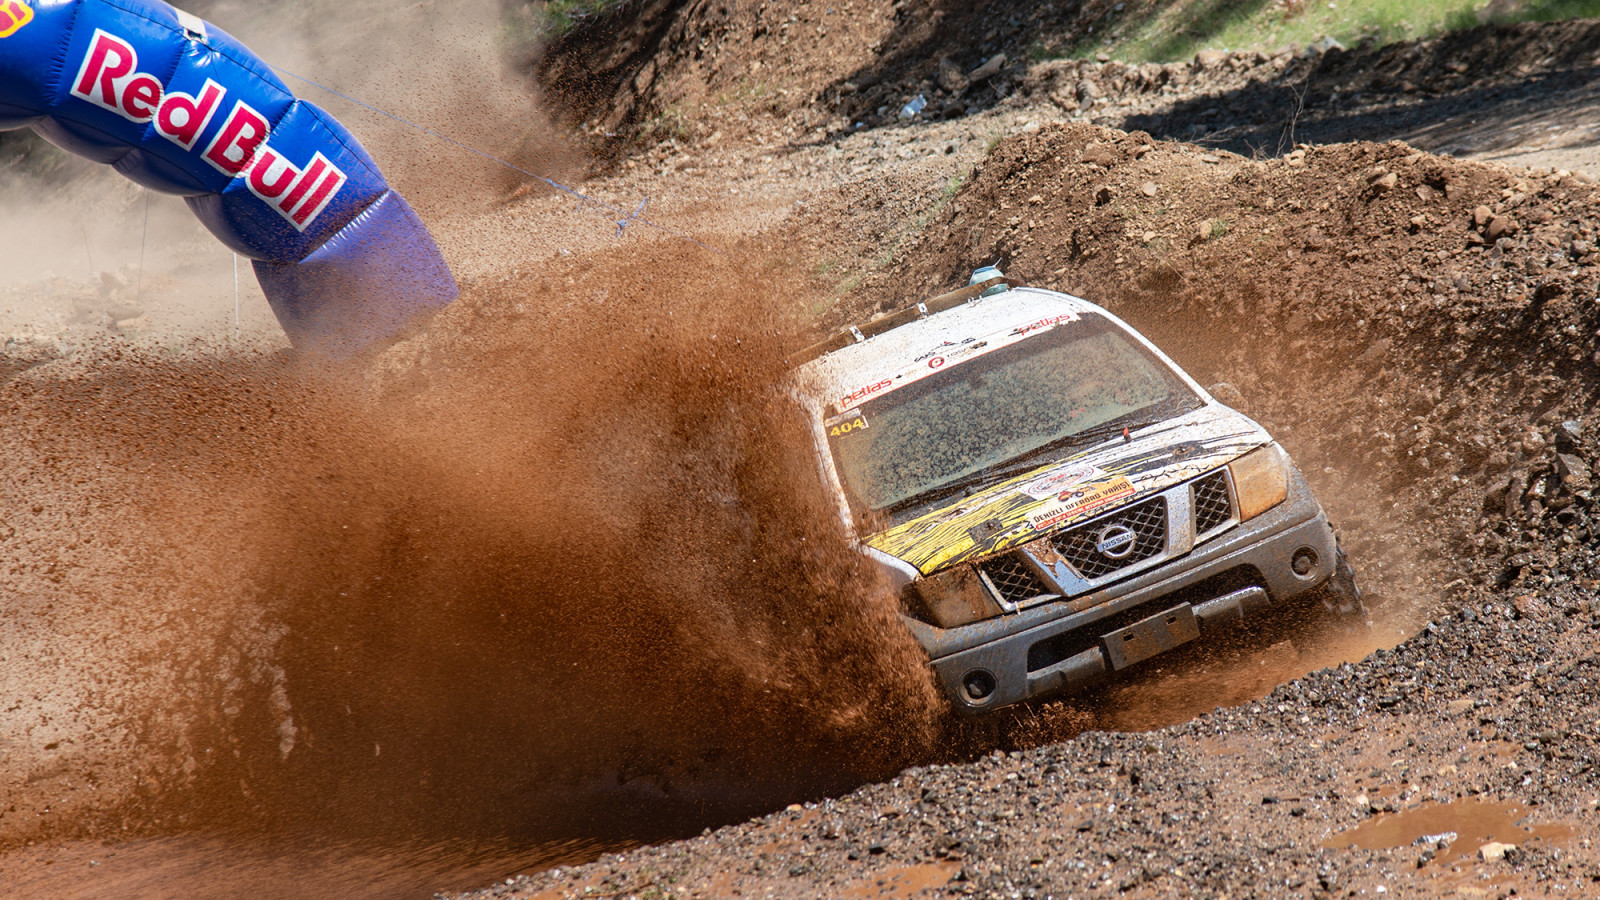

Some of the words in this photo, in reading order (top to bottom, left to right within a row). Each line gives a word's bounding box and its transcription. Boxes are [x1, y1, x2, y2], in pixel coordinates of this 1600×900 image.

[71, 28, 227, 151] Red
[201, 99, 347, 232] Bull
[840, 378, 892, 408] petlas
[831, 418, 864, 436] 404
[1065, 493, 1101, 510] OFFROAD
[1102, 533, 1133, 549] NISSAN
